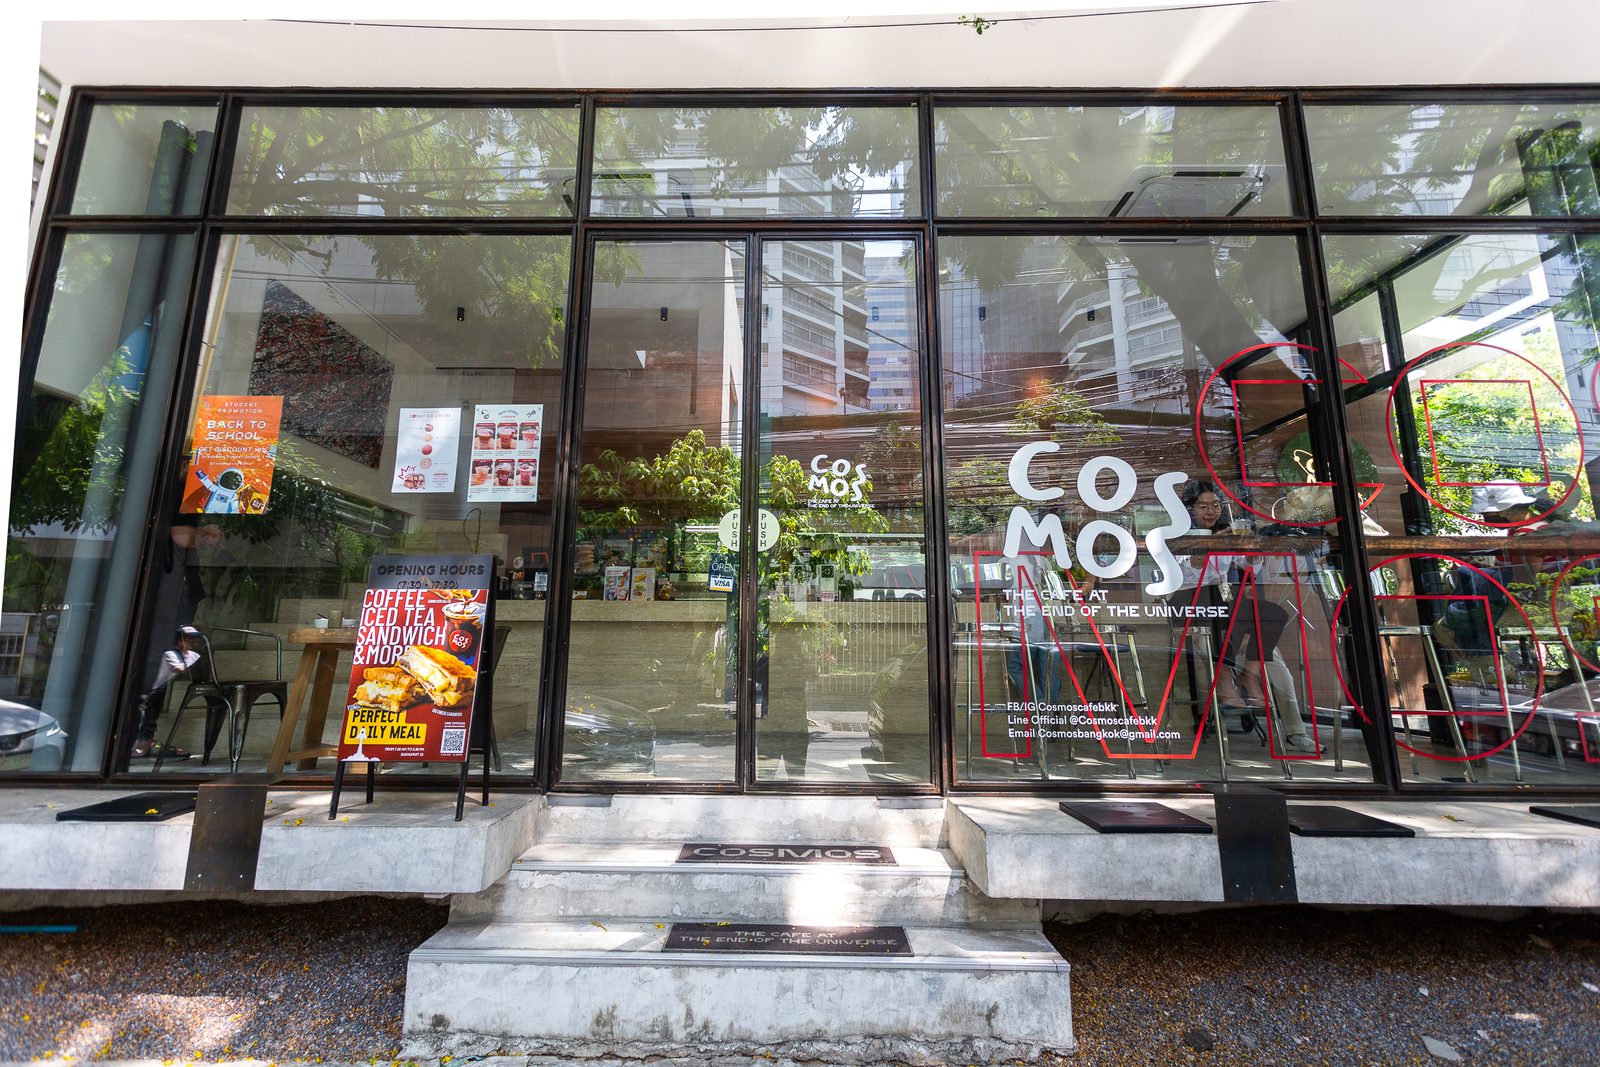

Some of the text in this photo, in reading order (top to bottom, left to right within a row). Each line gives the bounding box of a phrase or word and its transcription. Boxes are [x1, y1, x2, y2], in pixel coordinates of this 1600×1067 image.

[206, 420, 266, 429] BACK TO
[206, 431, 262, 440] SCHOOL
[377, 565, 485, 576] OPENING HOURS
[711, 562, 736, 572] OPEN
[363, 589, 428, 608] COFFEE
[1003, 590, 1109, 601] THE CAFE AT
[360, 607, 435, 626] ICED TEA
[1004, 606, 1230, 618] THE END OF THE UNIVERSE
[356, 626, 447, 646] SANDWICH
[1006, 702, 1118, 712] FB/IG Cosmoscafebkk
[352, 710, 401, 723] PERFECT
[1008, 715, 1158, 726] Line Official @Cosmoscafebkk
[350, 726, 421, 739] DILY MEAL
[1008, 729, 1181, 740] Email Cosmosbangkok@gmail.com
[693, 847, 881, 859] COSMOS
[815, 938, 898, 946] UNIVERSE
